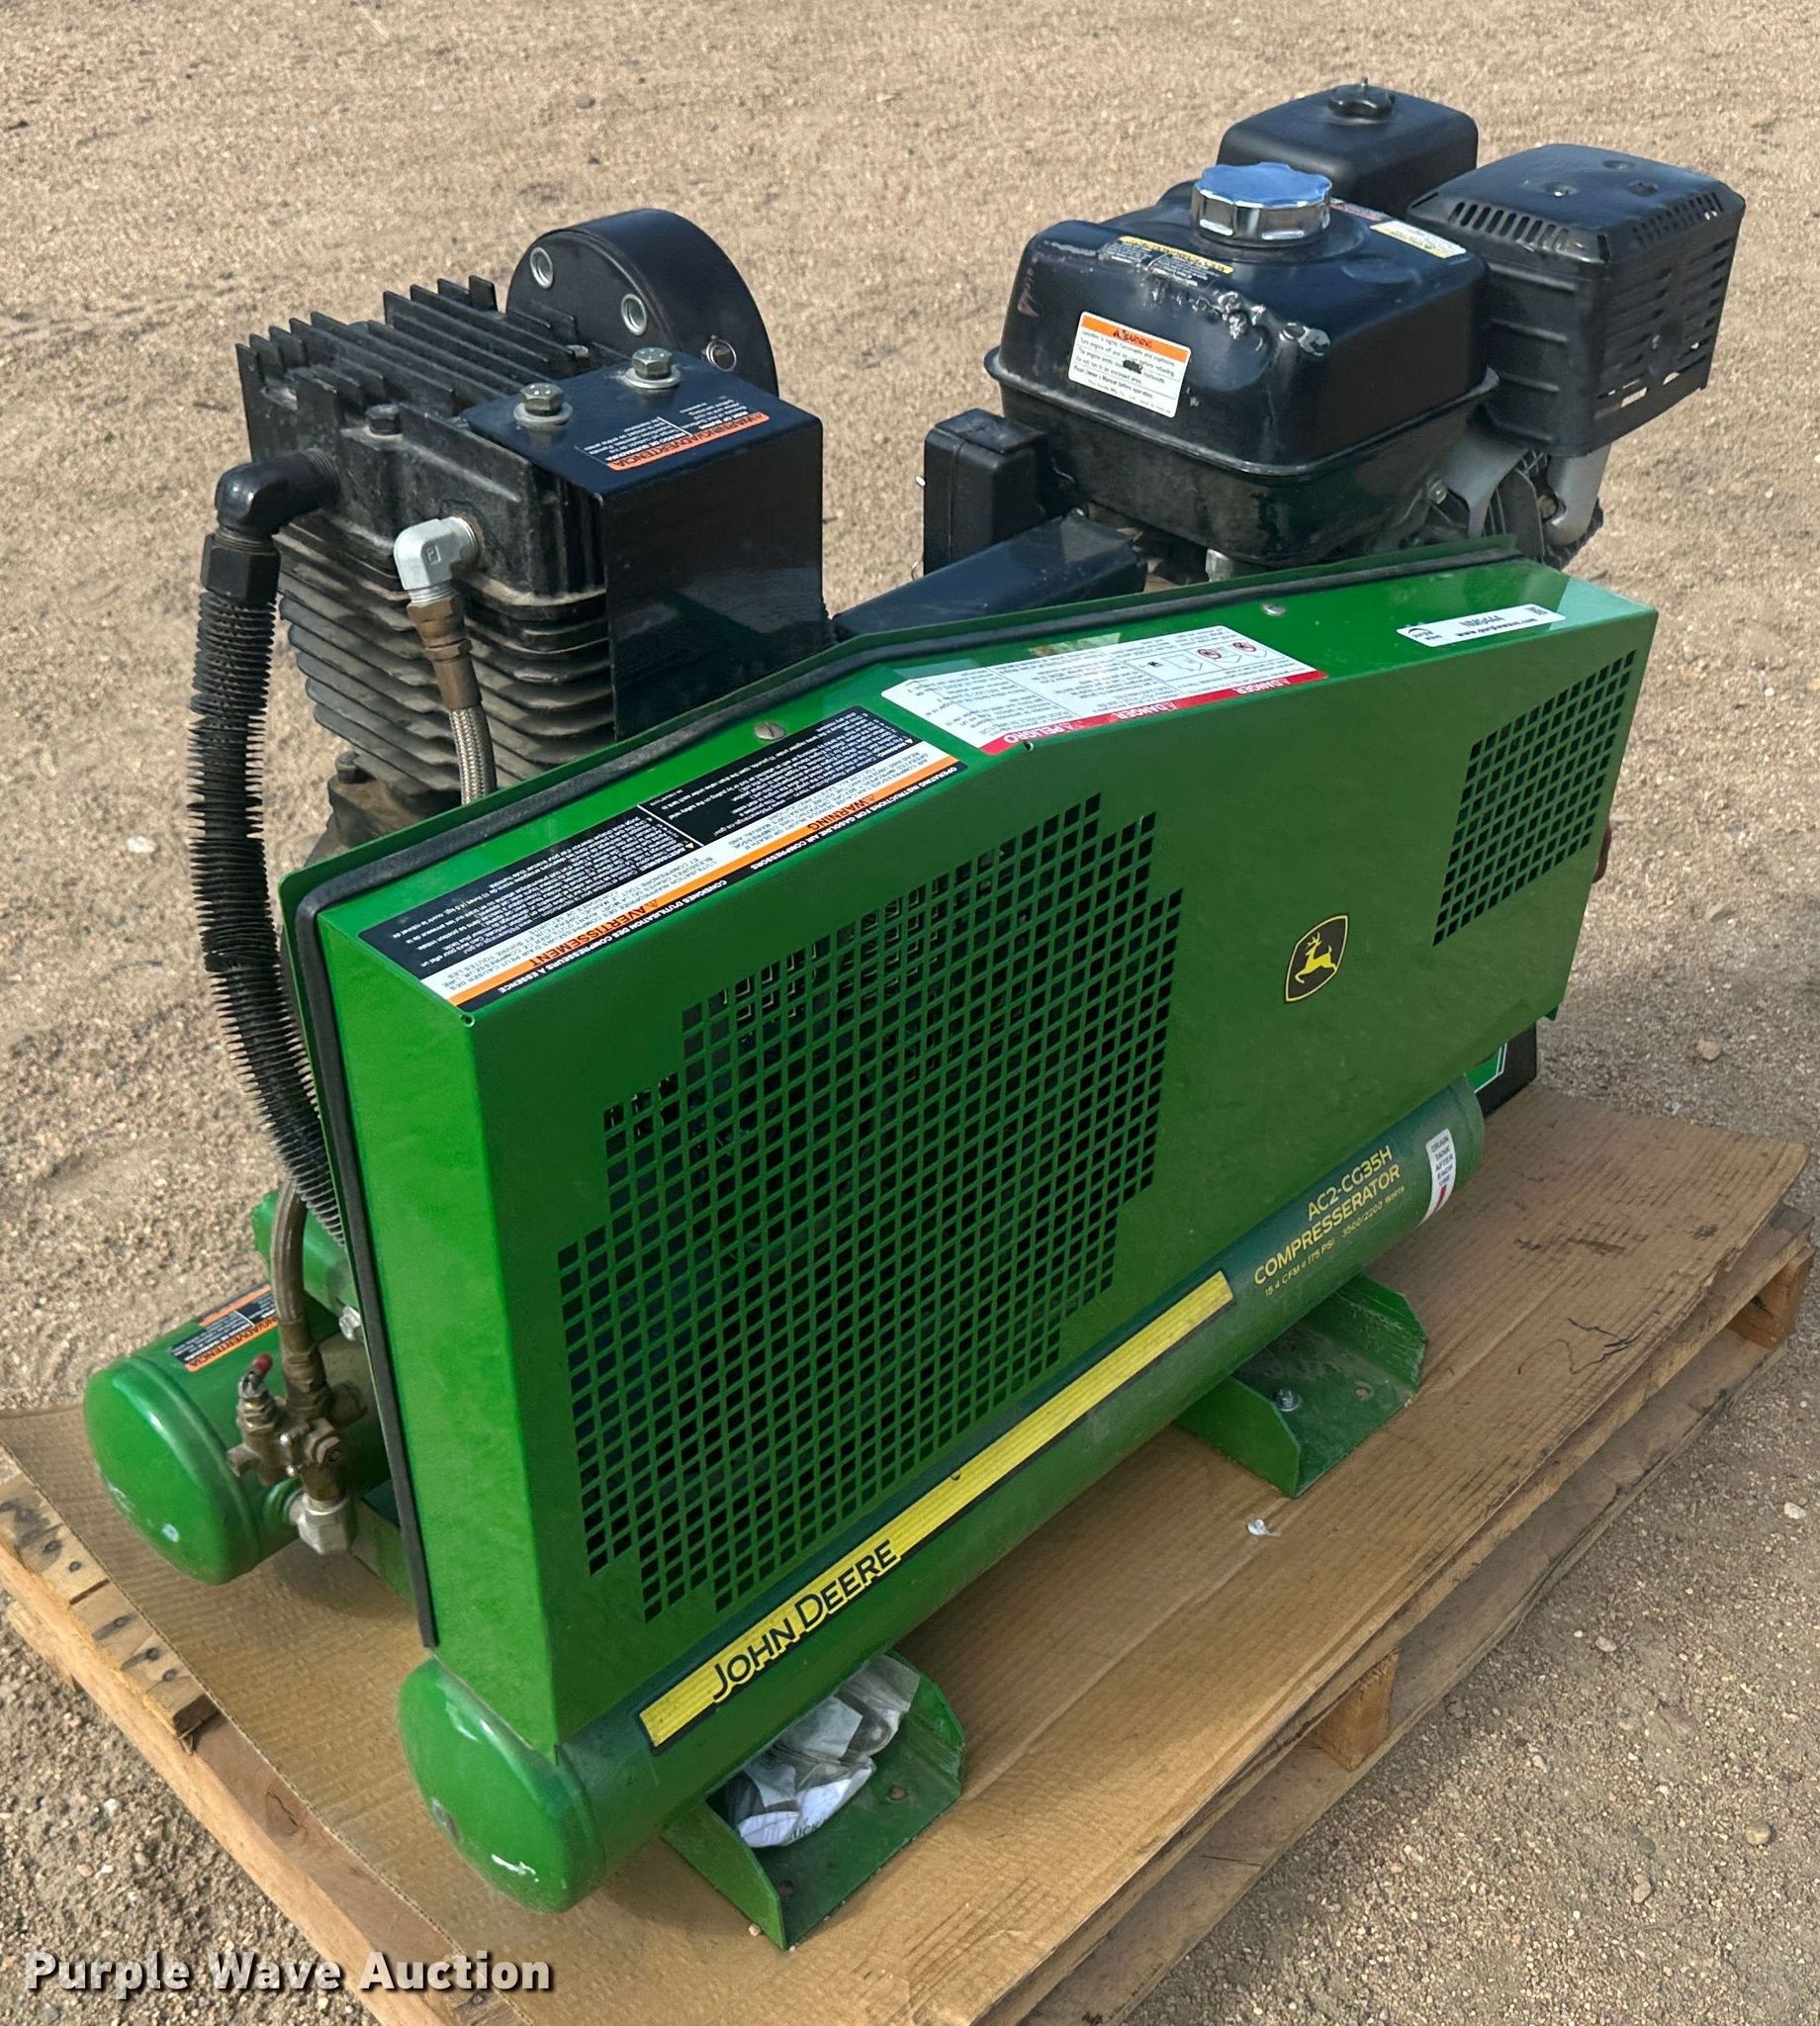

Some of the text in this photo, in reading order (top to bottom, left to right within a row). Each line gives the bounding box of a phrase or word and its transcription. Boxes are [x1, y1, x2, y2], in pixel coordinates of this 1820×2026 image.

[1237, 680, 1279, 694] DANGER
[1117, 702, 1164, 719] DANGER
[1003, 723, 1061, 744] PELIGRO
[749, 766, 958, 870] OPERATING INSTRUCTIONS FOR GASOLINE AIR COMPRESSORS
[805, 798, 869, 830] WARNING
[681, 879, 728, 903] CONSIGNES
[627, 900, 684, 929] D'UTILISATION
[525, 905, 649, 967] AVERTISSEMENT
[609, 927, 630, 938] DES
[544, 935, 613, 969] COMPRESSEURS
[496, 970, 539, 993] ESSENCE
[1434, 1145, 1450, 1160] TANK
[1436, 1153, 1453, 1170] AFTER
[1308, 1146, 1393, 1221] AC2-CG35H
[1437, 1163, 1453, 1179] EACH
[1254, 1164, 1401, 1285] COMPRESSERATOR
[1282, 1264, 1301, 1284] CFM
[1307, 1251, 1320, 1264] 175
[1320, 1238, 1335, 1253] PSI
[713, 1539, 897, 1702] JOHN DEERE
